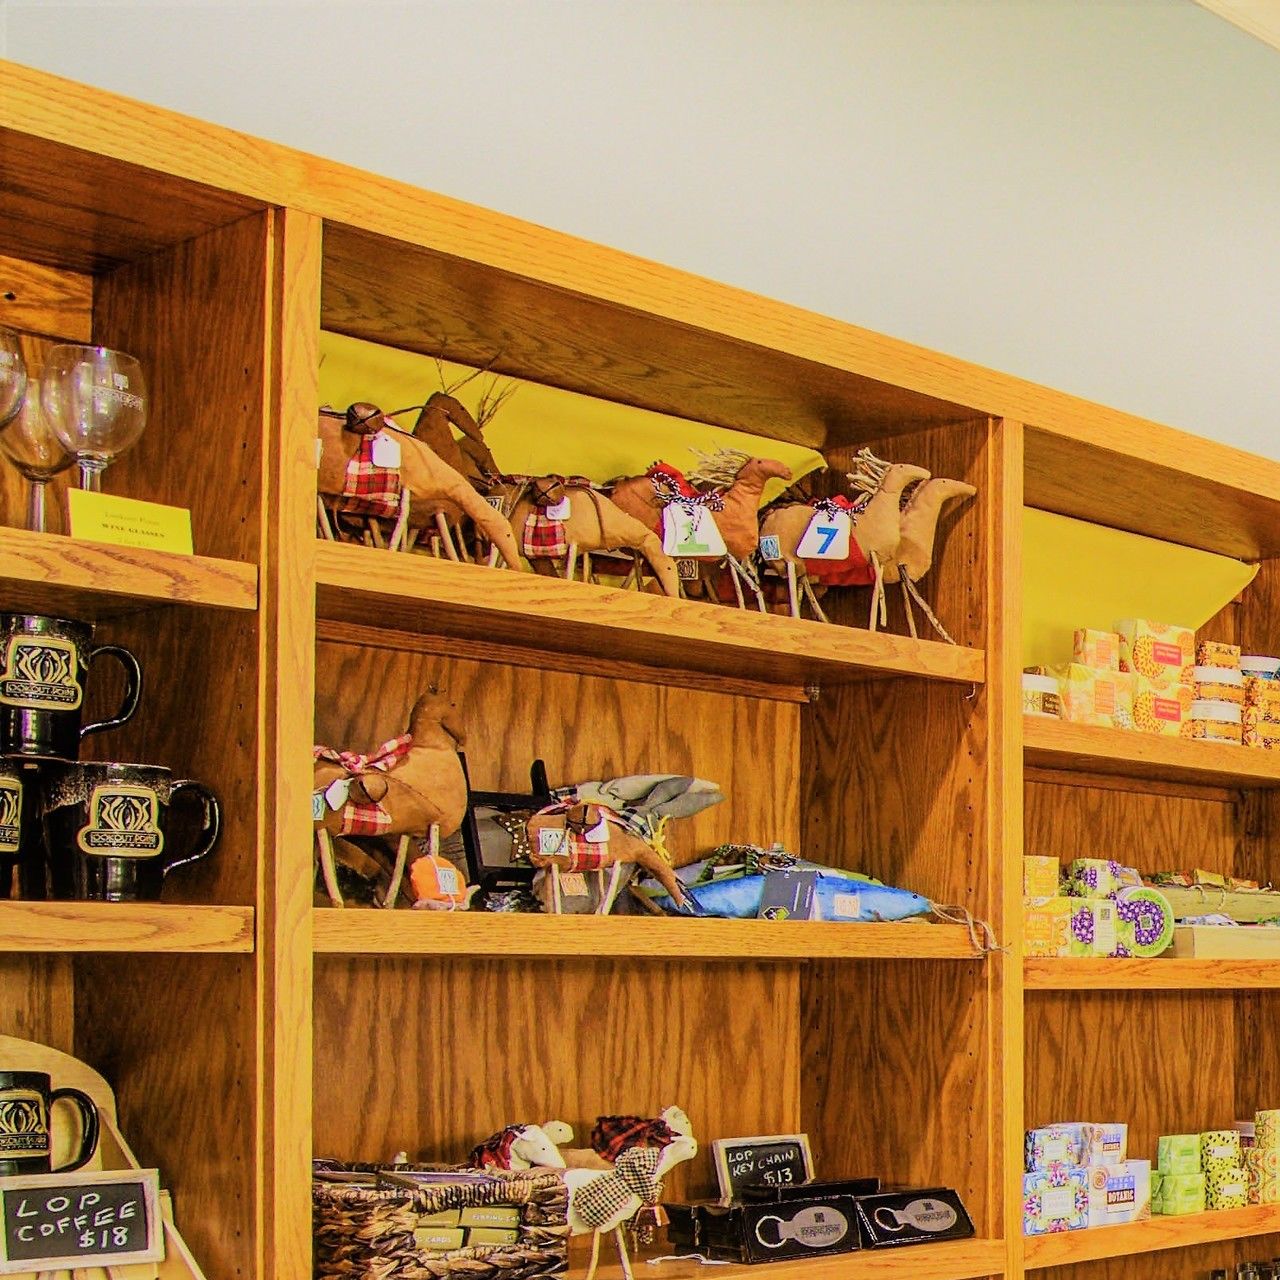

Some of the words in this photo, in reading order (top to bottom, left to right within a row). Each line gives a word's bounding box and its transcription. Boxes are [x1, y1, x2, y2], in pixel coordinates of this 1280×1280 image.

[815, 526, 839, 554] 7
[728, 1150, 753, 1164] LOP
[733, 1162, 755, 1177] KEY
[758, 1151, 794, 1170] CHAIN
[763, 1167, 793, 1184] $13
[16, 1192, 101, 1219] LOP
[1107, 1189, 1134, 1203] BOTANIC
[17, 1200, 137, 1242] COFFEE
[78, 1226, 129, 1249] $18
